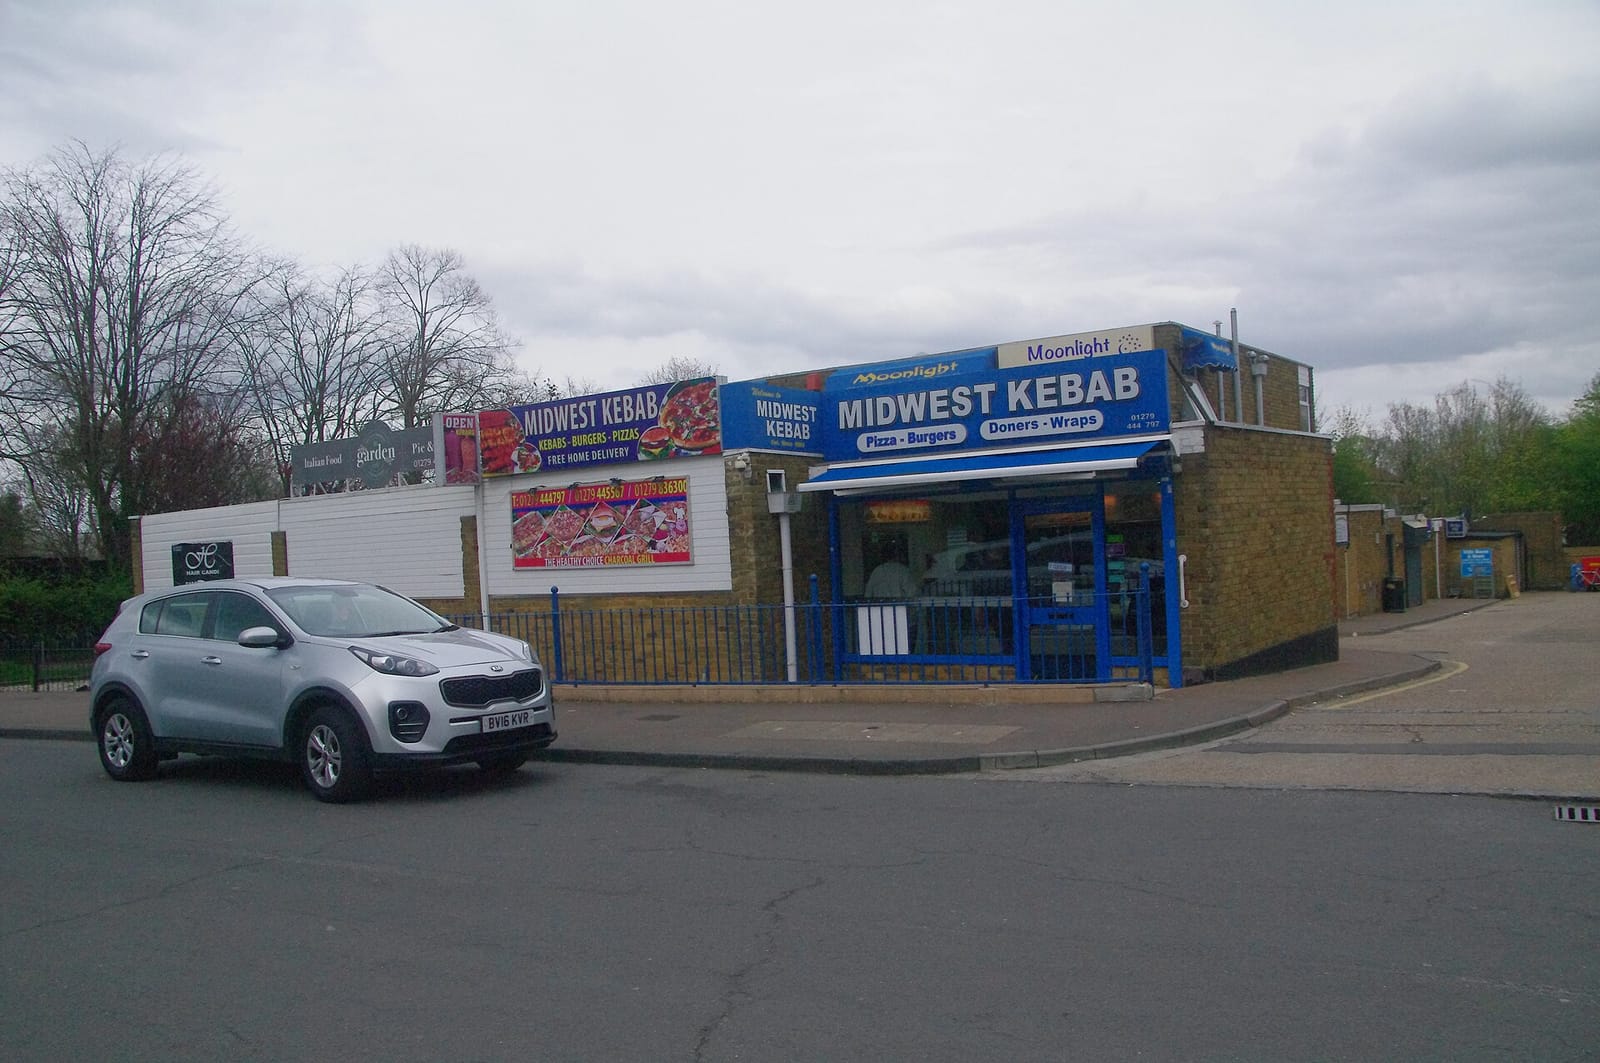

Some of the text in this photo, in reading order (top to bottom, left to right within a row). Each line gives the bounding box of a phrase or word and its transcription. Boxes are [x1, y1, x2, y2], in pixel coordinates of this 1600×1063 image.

[1027, 338, 1110, 362] Moonlight
[853, 361, 958, 385] Moonlight
[838, 366, 1140, 430] MIDWEST KEBAB
[525, 390, 658, 436] MIDWEST KEBAB
[756, 400, 817, 423] MIDWEST
[1131, 413, 1155, 421] 01279
[445, 416, 475, 429] OPEN
[766, 420, 811, 440] KEBAB
[988, 417, 1038, 435] Doners
[1051, 413, 1097, 432] Wraps
[539, 436, 567, 451] KEBABS
[572, 430, 607, 447] BURGERS
[612, 428, 640, 441] PIZZAS
[866, 434, 897, 448] Pizza
[907, 427, 957, 448] Burgers
[356, 443, 395, 468] garden
[412, 442, 425, 455] Pie
[547, 447, 629, 465] FREE HOME DELIVERY
[304, 453, 342, 468] Italian Food
[634, 482, 657, 497] 01279
[544, 553, 655, 567] THE HEALTHY CHOICE CHARCOAL GRILL
[488, 711, 529, 730] BV16 KVR
